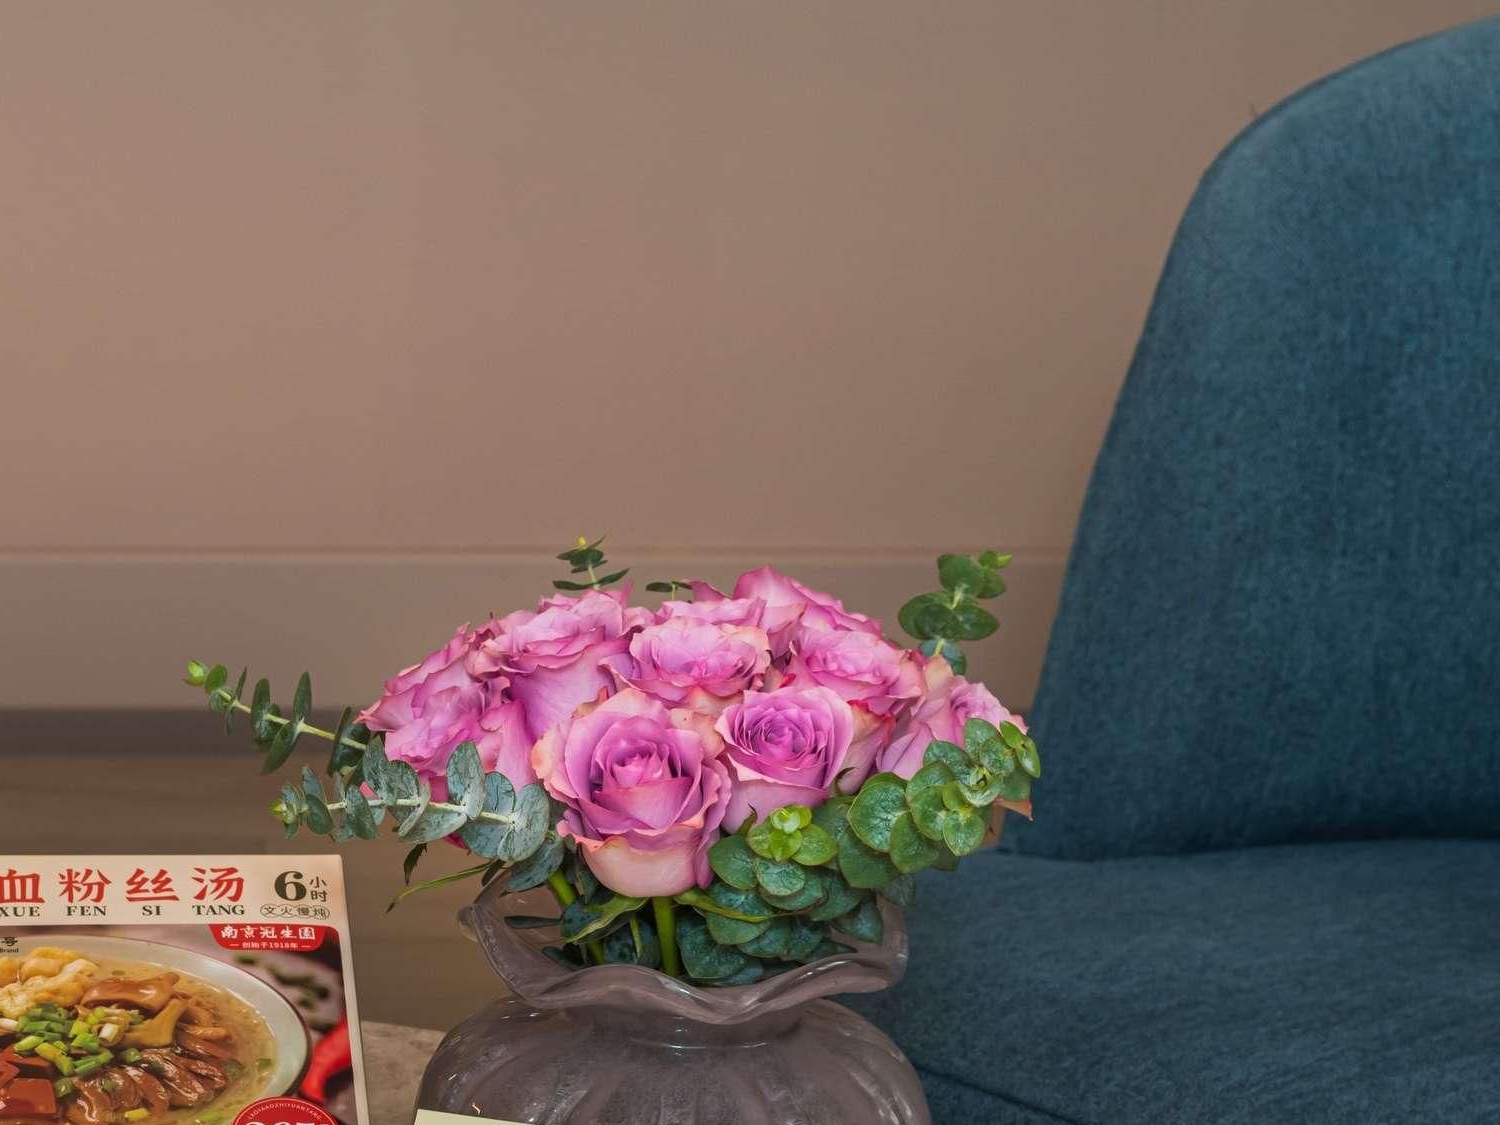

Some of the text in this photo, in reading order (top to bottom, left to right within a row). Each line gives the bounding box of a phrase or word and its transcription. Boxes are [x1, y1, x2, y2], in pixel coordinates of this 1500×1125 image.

[67, 906, 108, 917] FEN
[142, 905, 162, 916] SI
[192, 904, 246, 916] TANG
